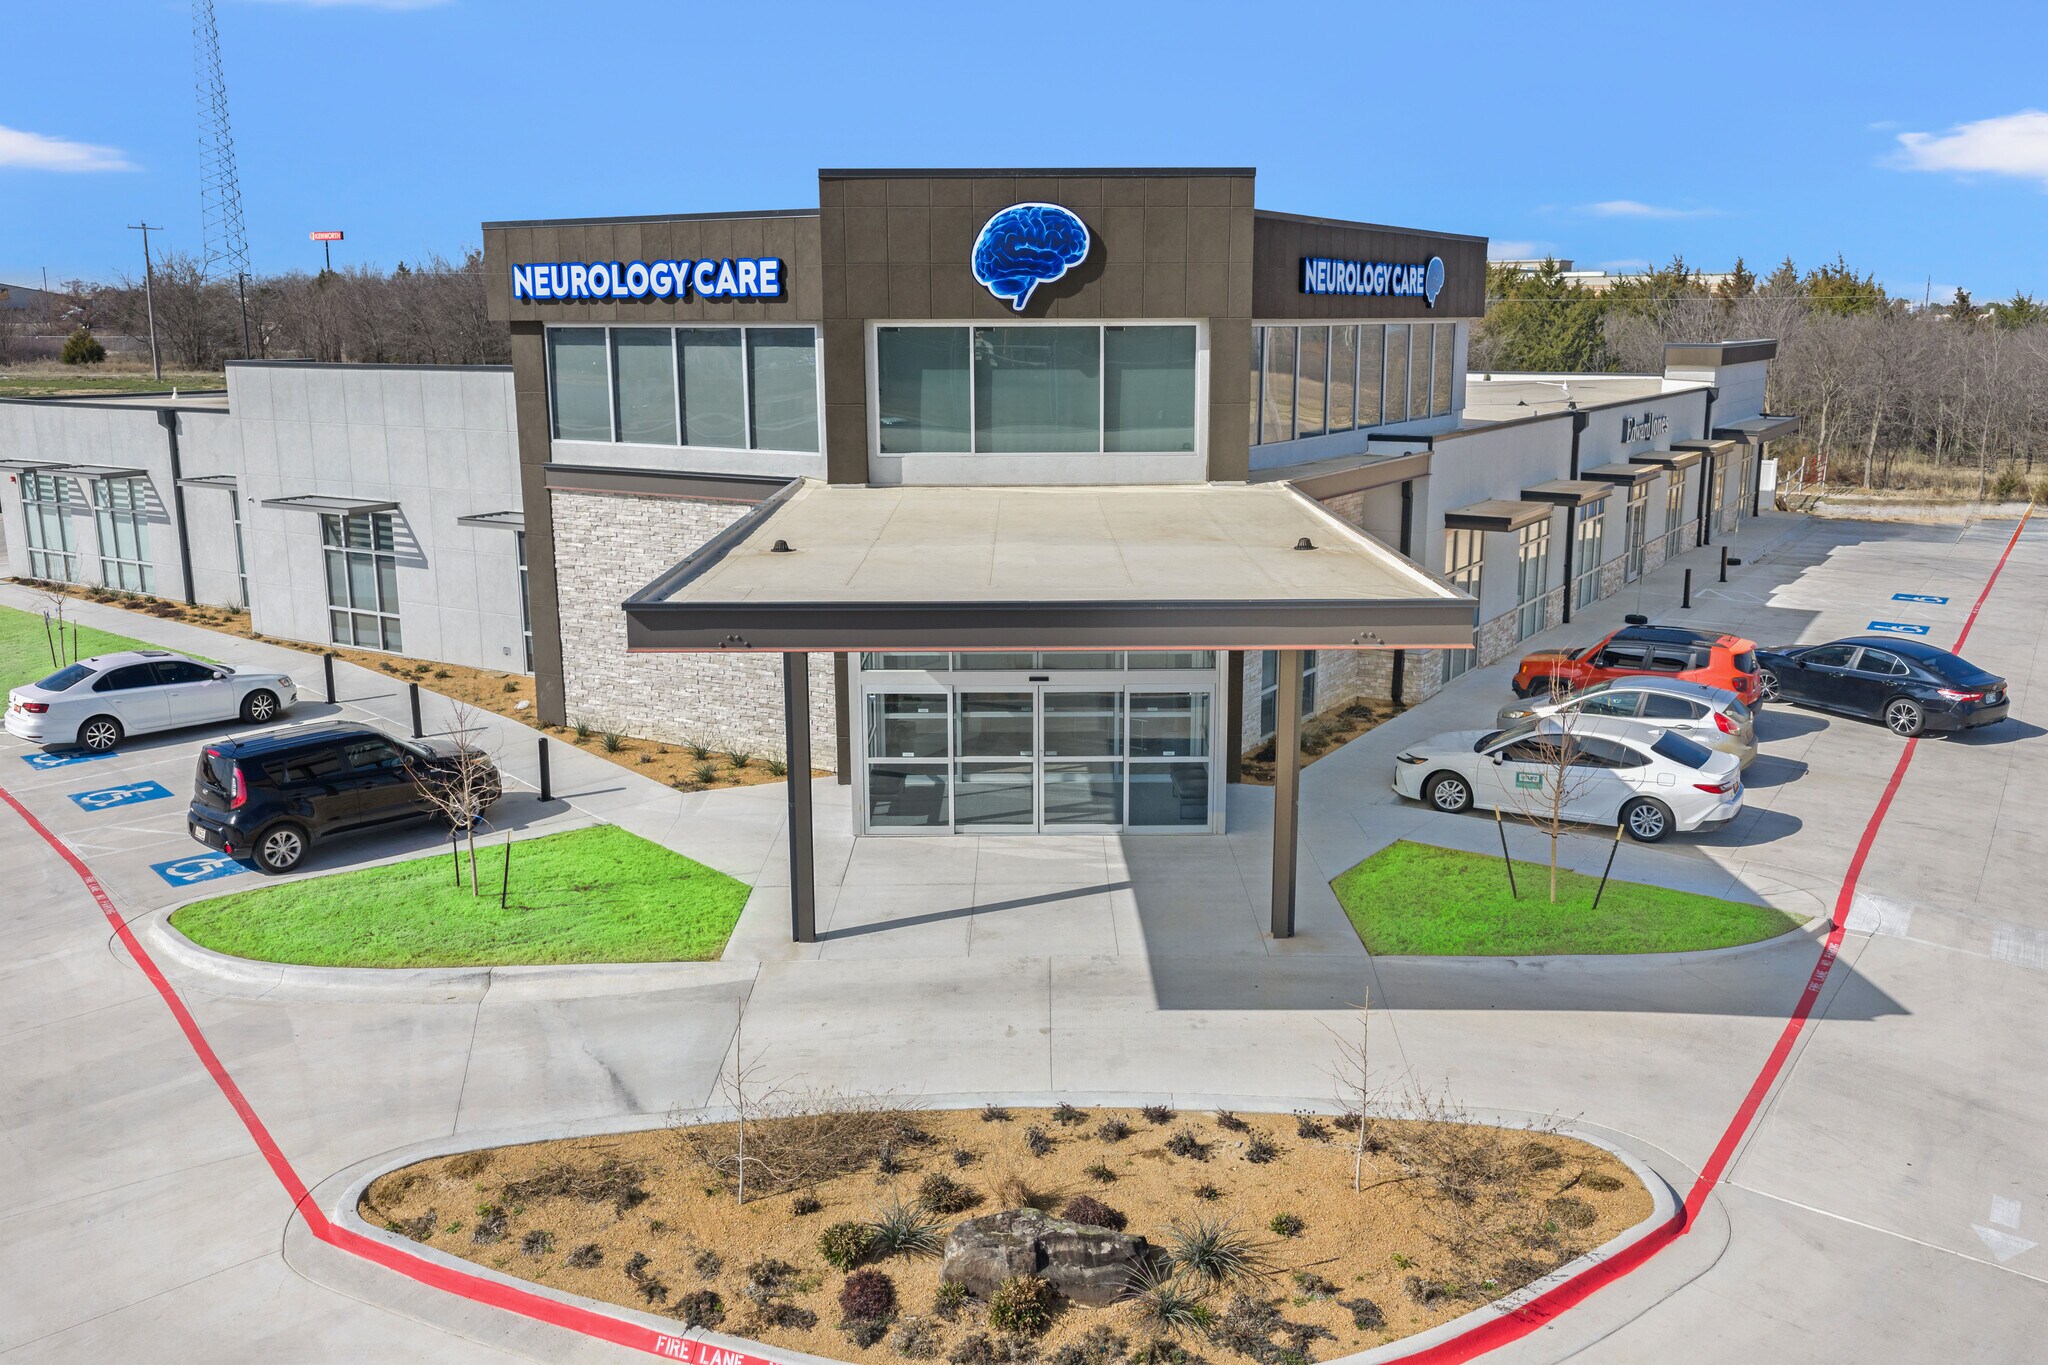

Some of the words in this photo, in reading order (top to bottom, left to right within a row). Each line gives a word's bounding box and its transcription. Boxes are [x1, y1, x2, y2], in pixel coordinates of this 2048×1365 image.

[512, 260, 690, 298] NEUROLOGY
[693, 258, 780, 297] CARE
[1304, 258, 1393, 295] NEUROLOGY
[1392, 263, 1425, 296] CARE
[1650, 413, 1669, 440] Jones
[656, 1335, 689, 1360] FIRE
[700, 1346, 744, 1365] LANE
